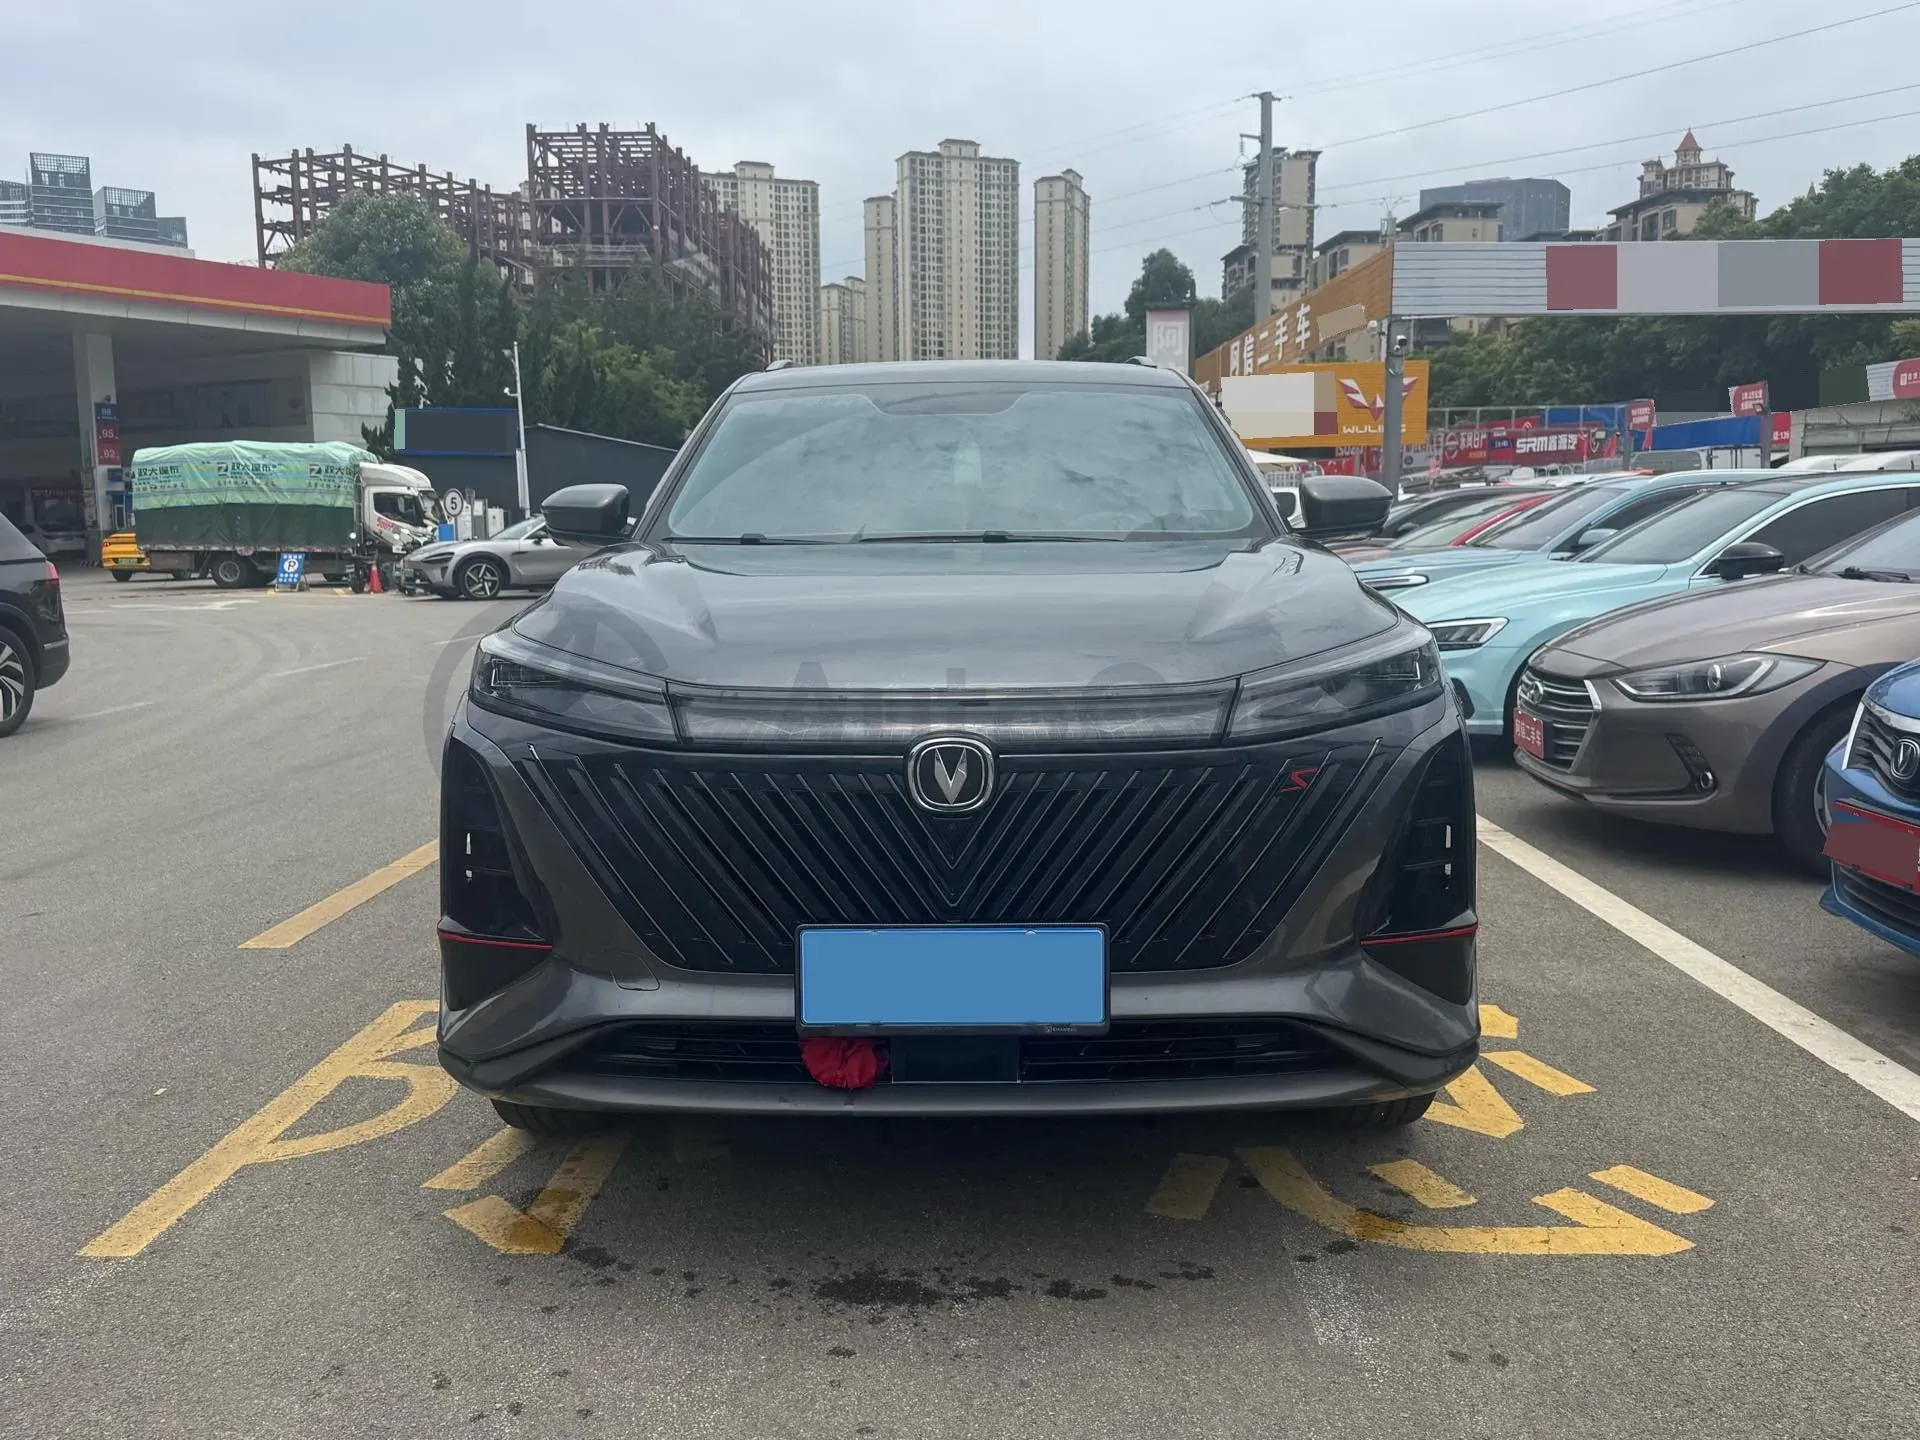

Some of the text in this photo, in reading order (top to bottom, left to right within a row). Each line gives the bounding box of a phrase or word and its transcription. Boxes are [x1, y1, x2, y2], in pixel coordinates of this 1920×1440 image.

[102, 428, 114, 438] 95
[1342, 424, 1407, 434] WULI
[450, 497, 458, 510] 5
